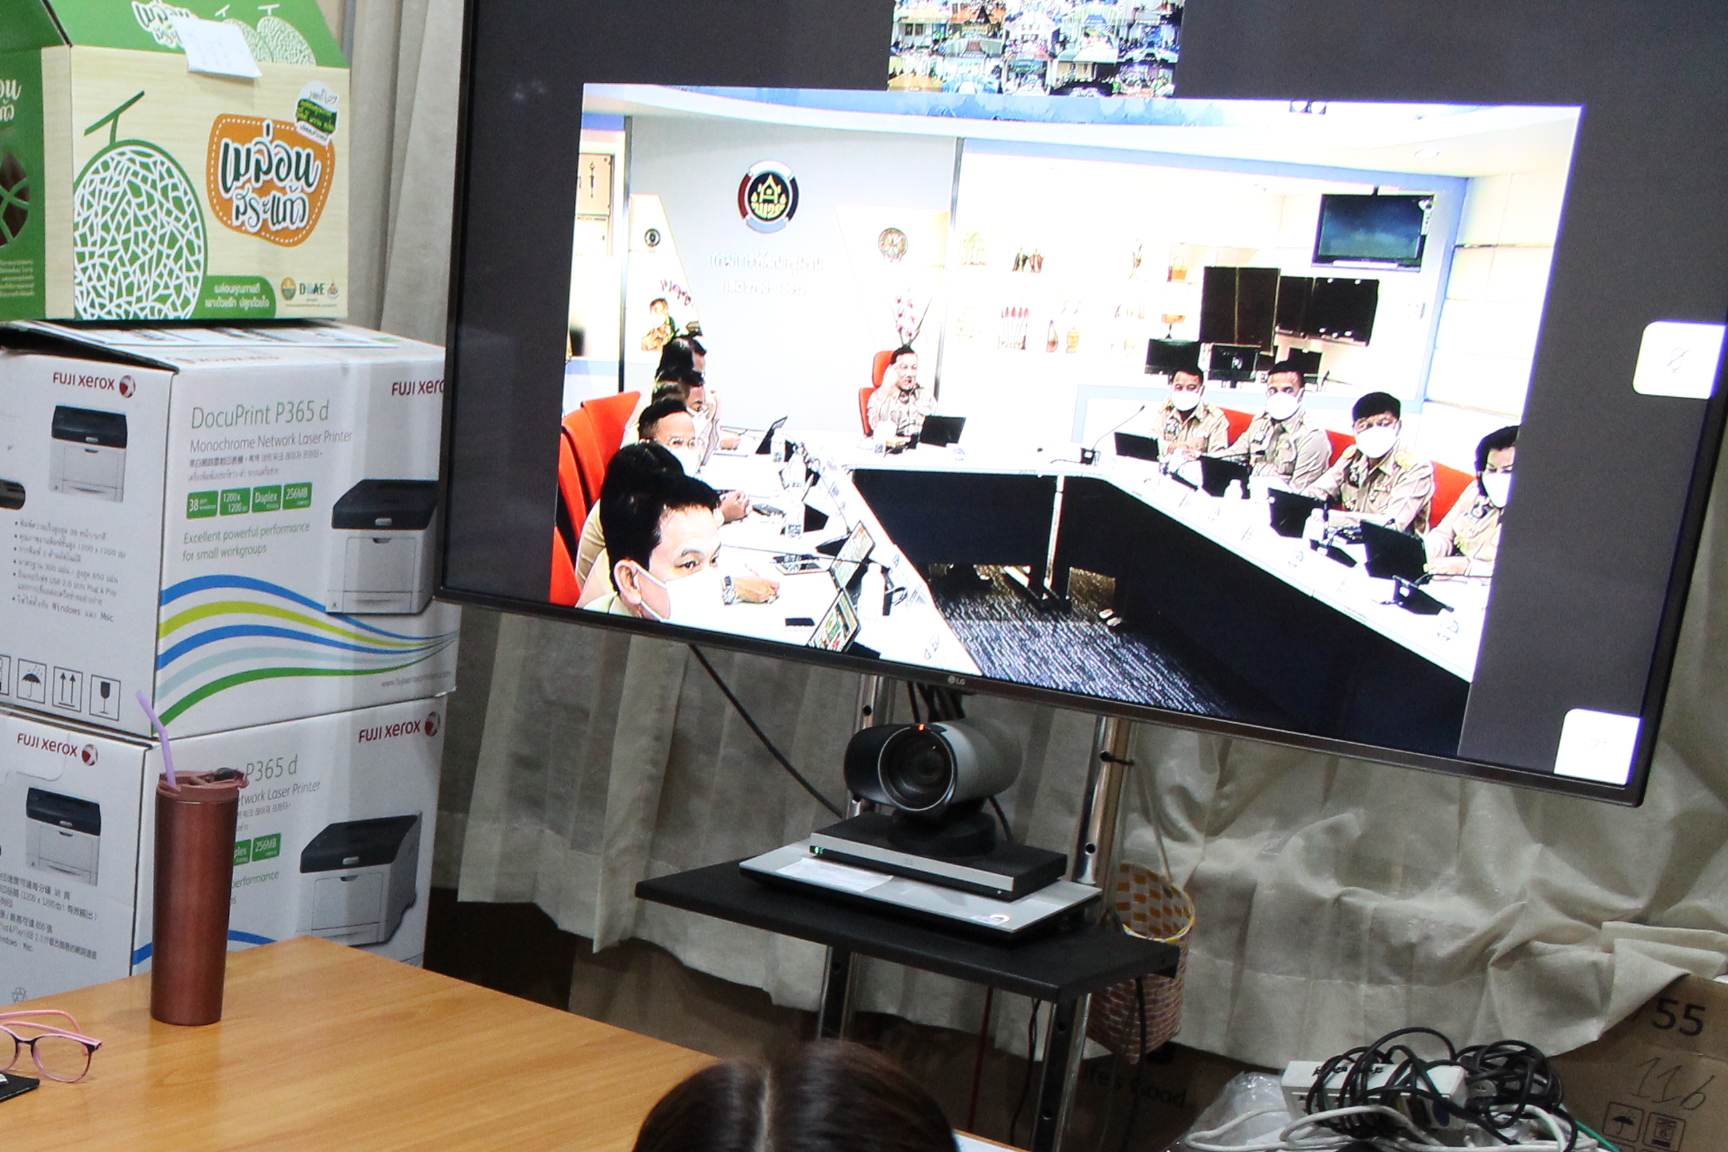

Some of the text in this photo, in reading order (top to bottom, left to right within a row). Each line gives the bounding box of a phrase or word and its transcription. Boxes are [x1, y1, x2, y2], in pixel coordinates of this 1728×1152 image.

[221, 122, 321, 195] เมล่อน
[52, 372, 115, 391] FUJI xerox
[391, 380, 445, 396] FUJI xero
[191, 399, 330, 430] DocuPrint P365 d
[190, 430, 353, 453] Monochrome Network Laser Printer
[254, 491, 278, 504] Duplex
[183, 522, 311, 545] Excellent powerful performance
[182, 544, 267, 561] for small workgroups
[359, 719, 421, 742] FUJI xerox
[16, 733, 78, 758] FUJI xerox
[245, 754, 298, 782] P365 d
[267, 781, 321, 801] Laser Printer
[231, 870, 280, 890] performance
[1652, 997, 1706, 1037] 55
[1631, 1057, 1715, 1111] 116
